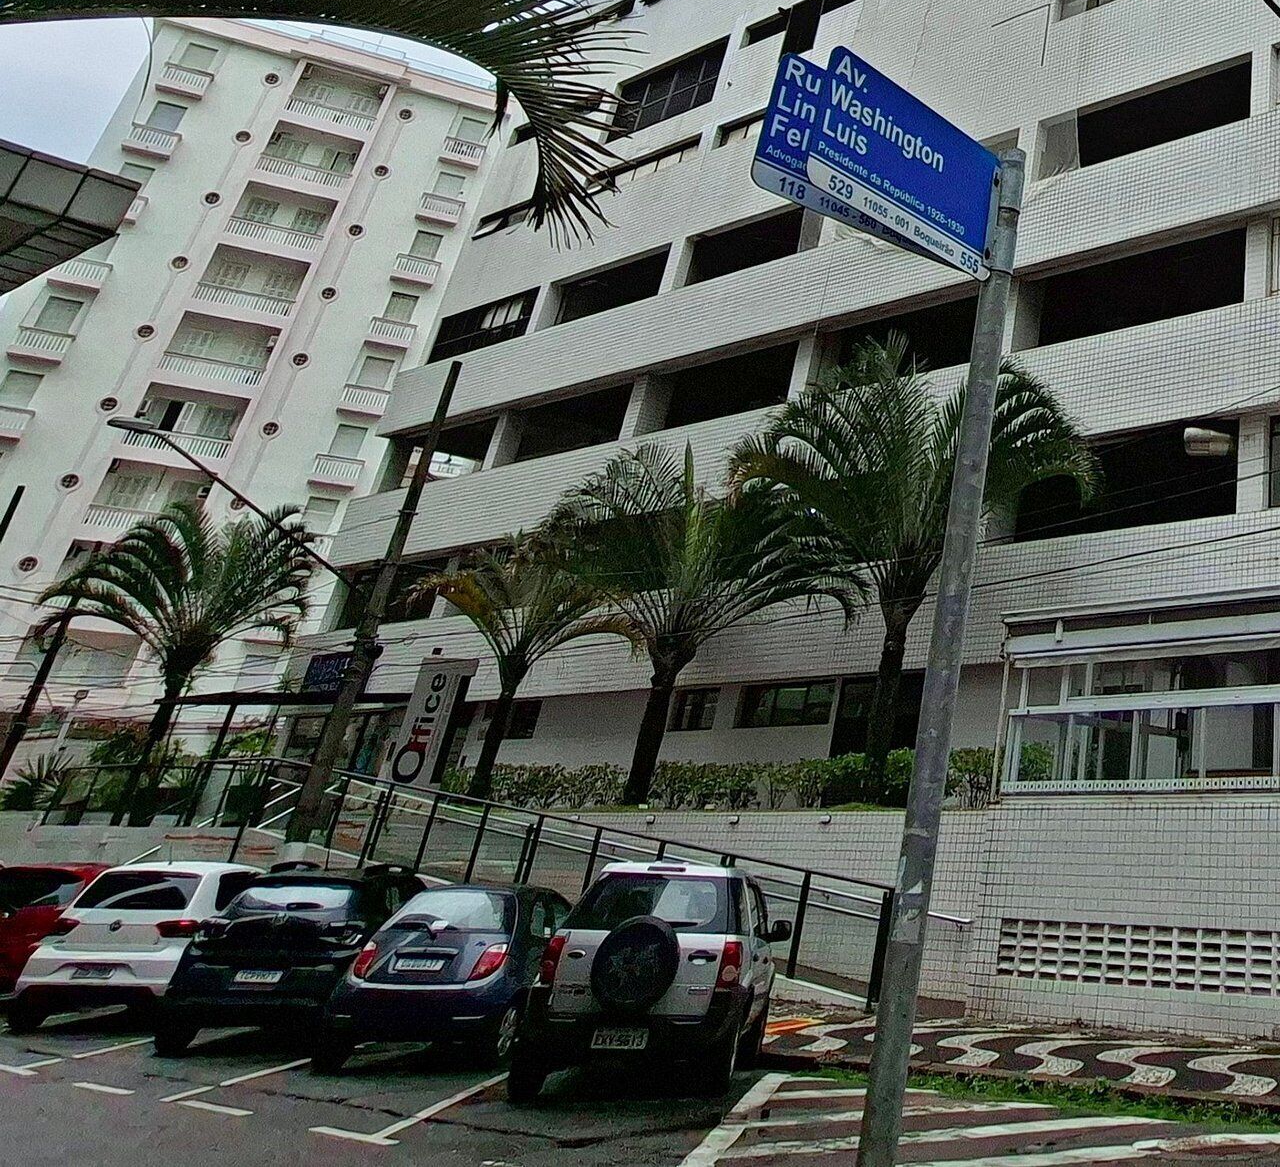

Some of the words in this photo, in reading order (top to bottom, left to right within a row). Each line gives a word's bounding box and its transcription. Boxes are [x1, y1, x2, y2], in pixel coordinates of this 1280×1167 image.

[835, 55, 867, 93] Av.
[822, 108, 868, 155] Luis
[831, 78, 945, 173] Washington
[779, 176, 806, 200] 118
[818, 141, 868, 177] Presidente
[870, 172, 882, 186] da
[883, 179, 925, 212] República
[828, 174, 853, 200] 529
[863, 196, 888, 219] 11055
[895, 214, 910, 232] 001
[914, 225, 955, 257] Boqueirão
[960, 251, 979, 274] 555
[392, 673, 447, 783] Office
